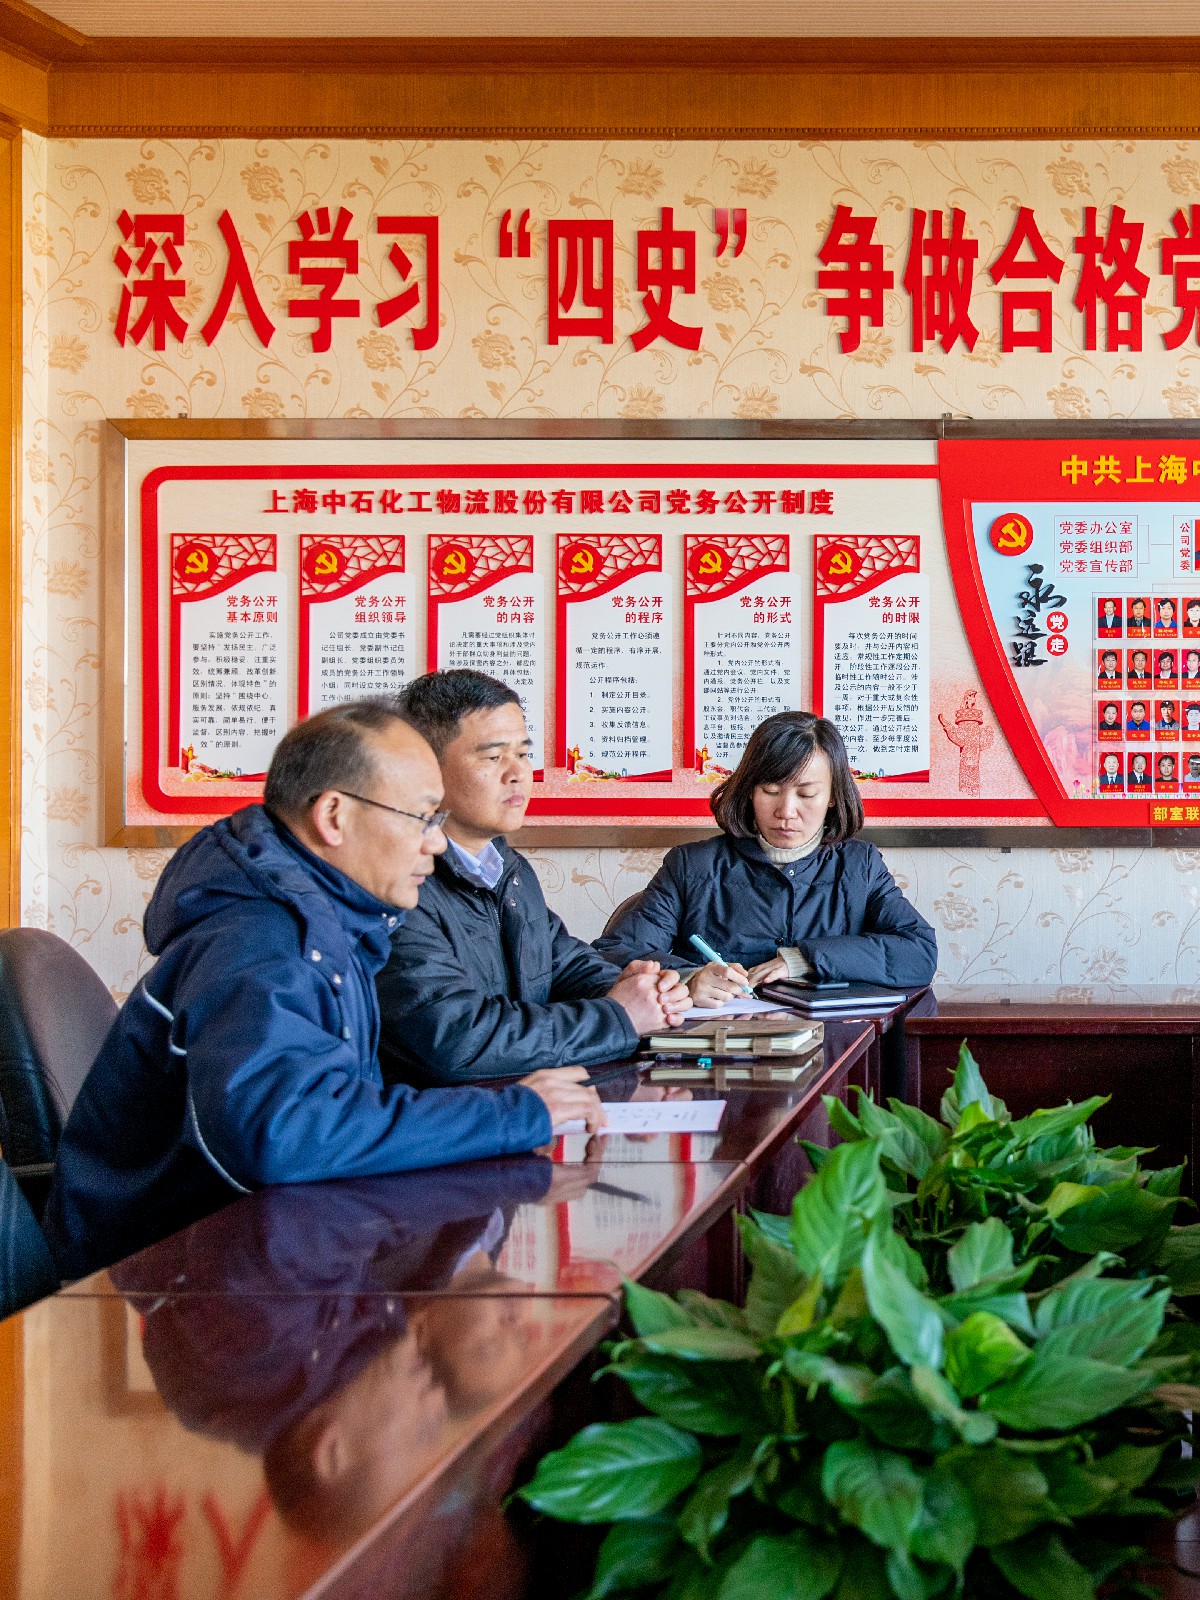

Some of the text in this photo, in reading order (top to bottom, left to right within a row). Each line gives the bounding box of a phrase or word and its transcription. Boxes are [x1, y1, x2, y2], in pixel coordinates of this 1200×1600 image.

[263, 488, 833, 515] 上海中石化工物流股份有限公司党务公开制度
[1059, 521, 1133, 535] 党委办公室
[1059, 539, 1133, 554] 党委组织部
[1179, 522, 1191, 571] 公司党委
[1059, 559, 1133, 573] 党委宣传部
[226, 594, 277, 608] 党务公开
[354, 594, 407, 608] 党务公开
[483, 595, 534, 608] 党务公开
[611, 595, 663, 608] 党务公开
[739, 595, 791, 608] 党务公开
[868, 595, 920, 608] 党务公开
[226, 610, 278, 623] 基本原则
[354, 611, 406, 623] 组织领导
[496, 611, 535, 623] 的内容
[624, 611, 663, 624] 的程序
[753, 611, 792, 624] 的形式
[881, 611, 920, 624] 的时限
